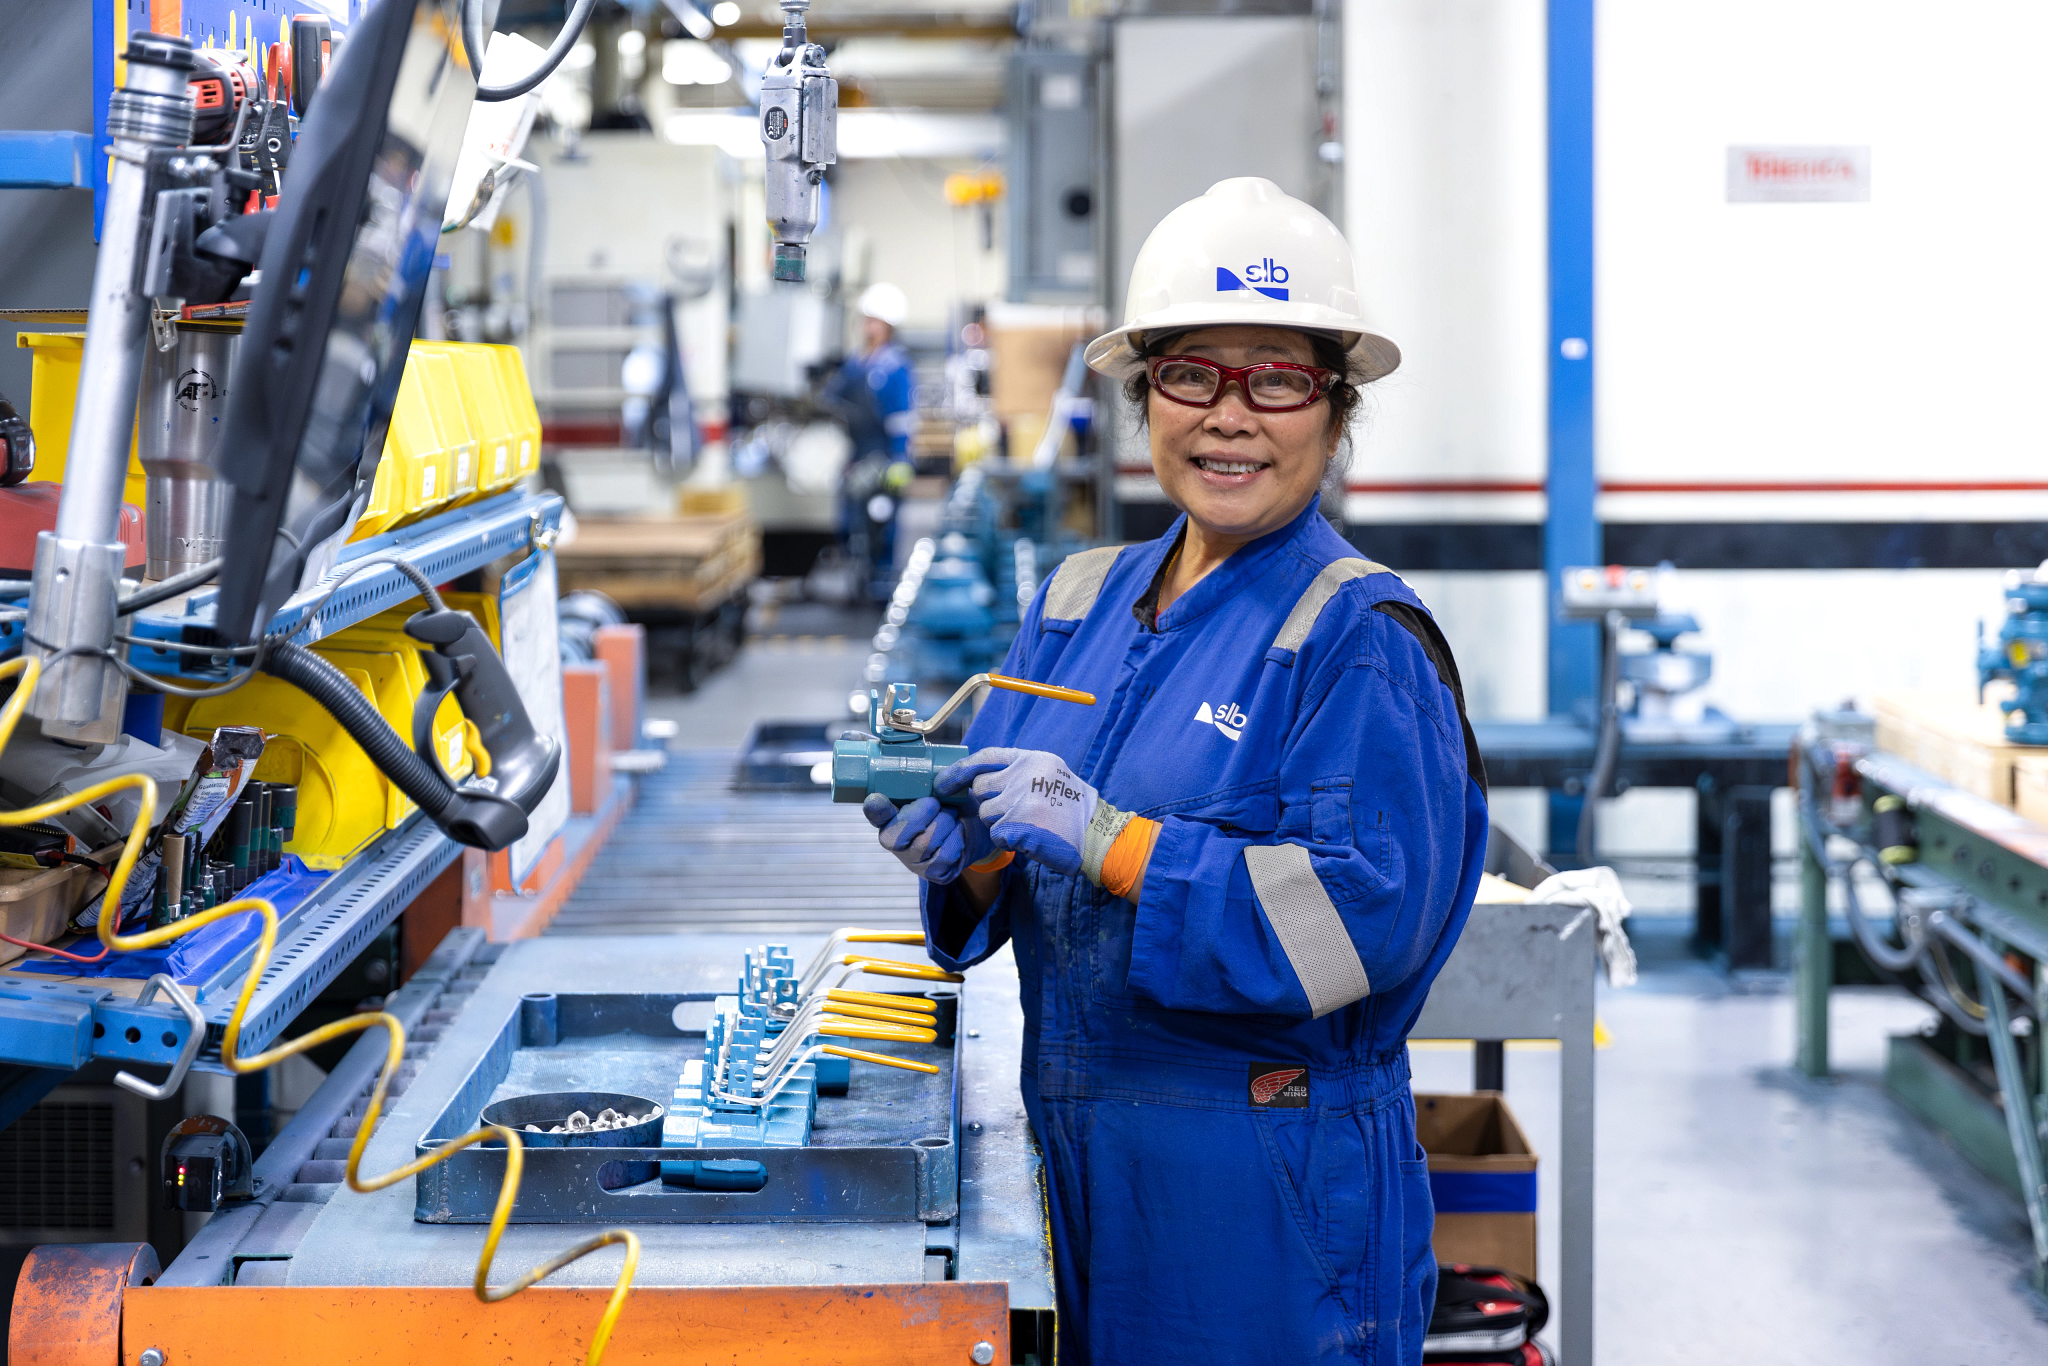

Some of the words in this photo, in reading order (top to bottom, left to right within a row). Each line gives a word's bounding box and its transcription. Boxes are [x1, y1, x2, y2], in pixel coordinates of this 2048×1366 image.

[1245, 257, 1289, 283] slb
[176, 536, 228, 558] YET
[1214, 701, 1247, 728] slb
[1031, 776, 1081, 802] HyFlex
